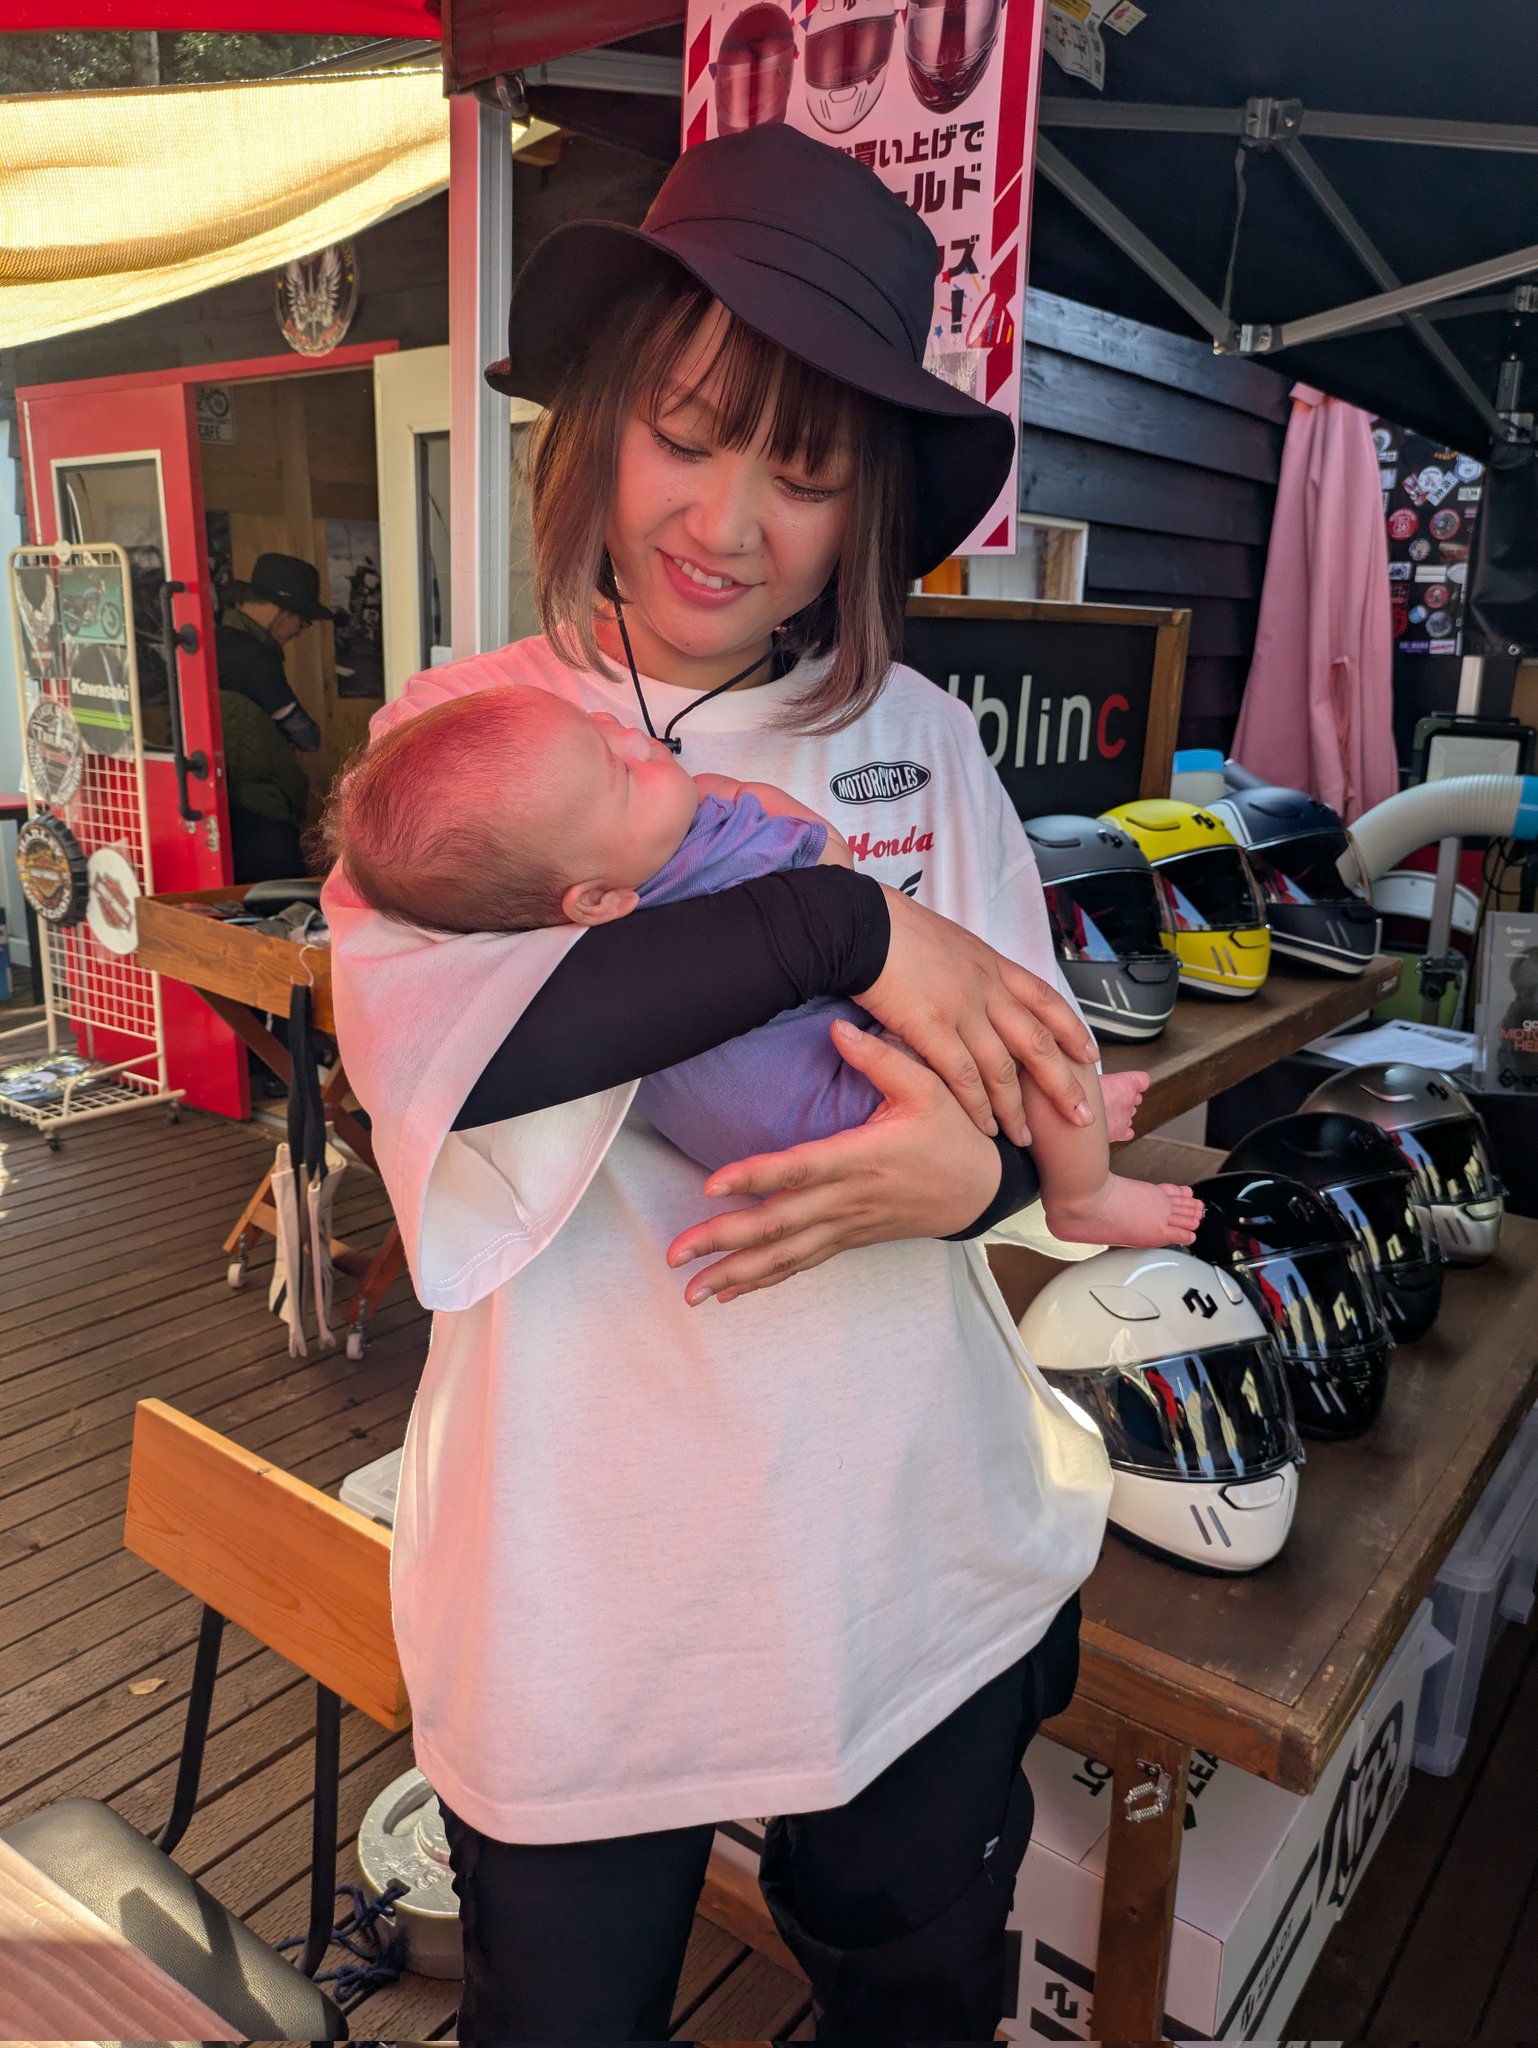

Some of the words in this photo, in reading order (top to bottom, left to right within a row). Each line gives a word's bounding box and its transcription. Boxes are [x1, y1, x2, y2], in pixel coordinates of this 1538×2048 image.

[837, 120, 985, 171] 買い上げで
[936, 234, 980, 278] ズ
[71, 677, 130, 702] Kawasaki
[947, 674, 1130, 769] blinc
[837, 766, 919, 800] MOTORCYCLES
[848, 825, 935, 862] Honda
